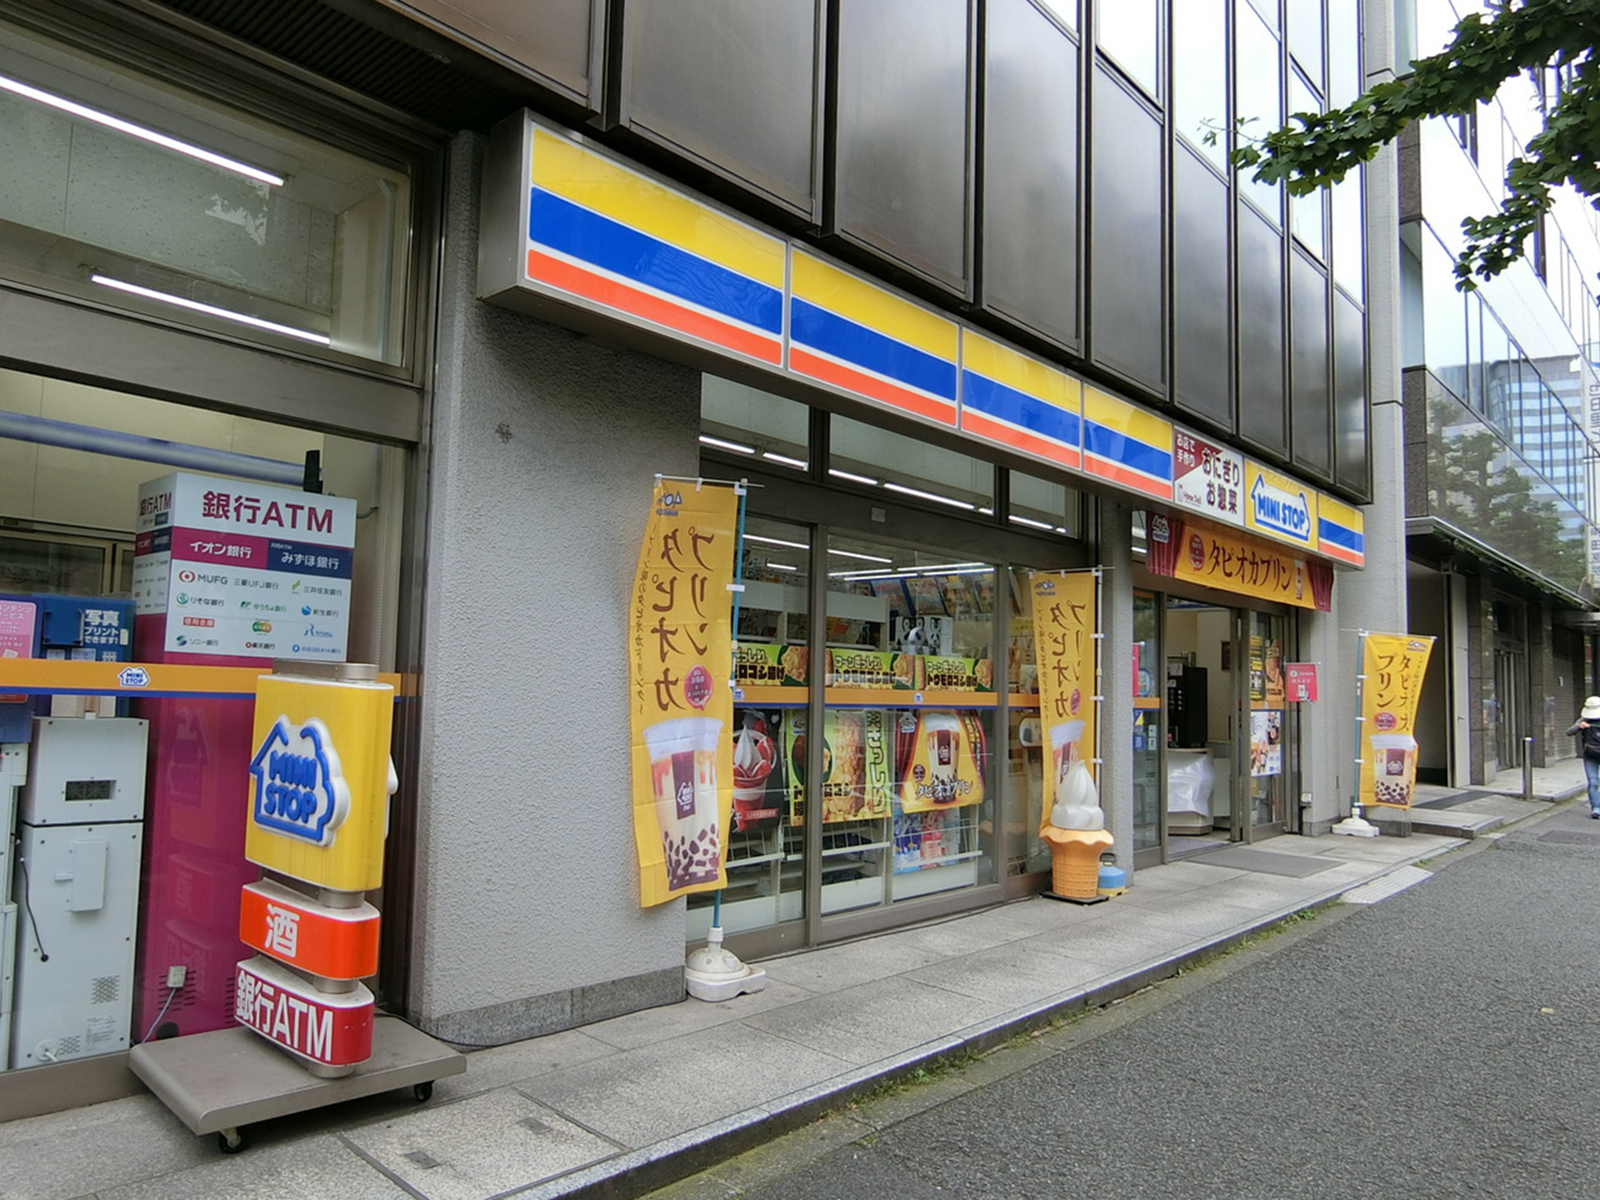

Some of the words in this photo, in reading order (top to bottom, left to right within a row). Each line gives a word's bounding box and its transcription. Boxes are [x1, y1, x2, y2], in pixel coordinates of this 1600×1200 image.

[1176, 434, 1195, 452] お店で
[1177, 449, 1195, 467] 手作り
[1201, 447, 1240, 487] おにぎり
[1206, 480, 1238, 514] お惣菜
[202, 491, 334, 534] 銀行ATM
[1257, 492, 1280, 522] MINI
[1281, 502, 1305, 531] STOP
[190, 541, 252, 559] イオン銀行
[281, 552, 339, 570] みずほ銀行
[1207, 539, 1292, 592] タピオカプリン
[197, 574, 228, 585] MUFG
[233, 578, 279, 590] 三菱UFJ銀行
[0, 603, 33, 613] ンテンツ
[190, 597, 225, 607] りそな銀行
[253, 603, 286, 613] ゆうちょ銀行
[85, 609, 119, 626] 写真
[84, 626, 119, 636] プリント
[1376, 652, 1398, 708] プリン
[269, 750, 317, 790] MINI
[915, 779, 974, 800] タピオカプリン
[264, 782, 318, 824] STOP
[264, 903, 300, 958] 酒
[235, 970, 334, 1062] 銀行ATM
